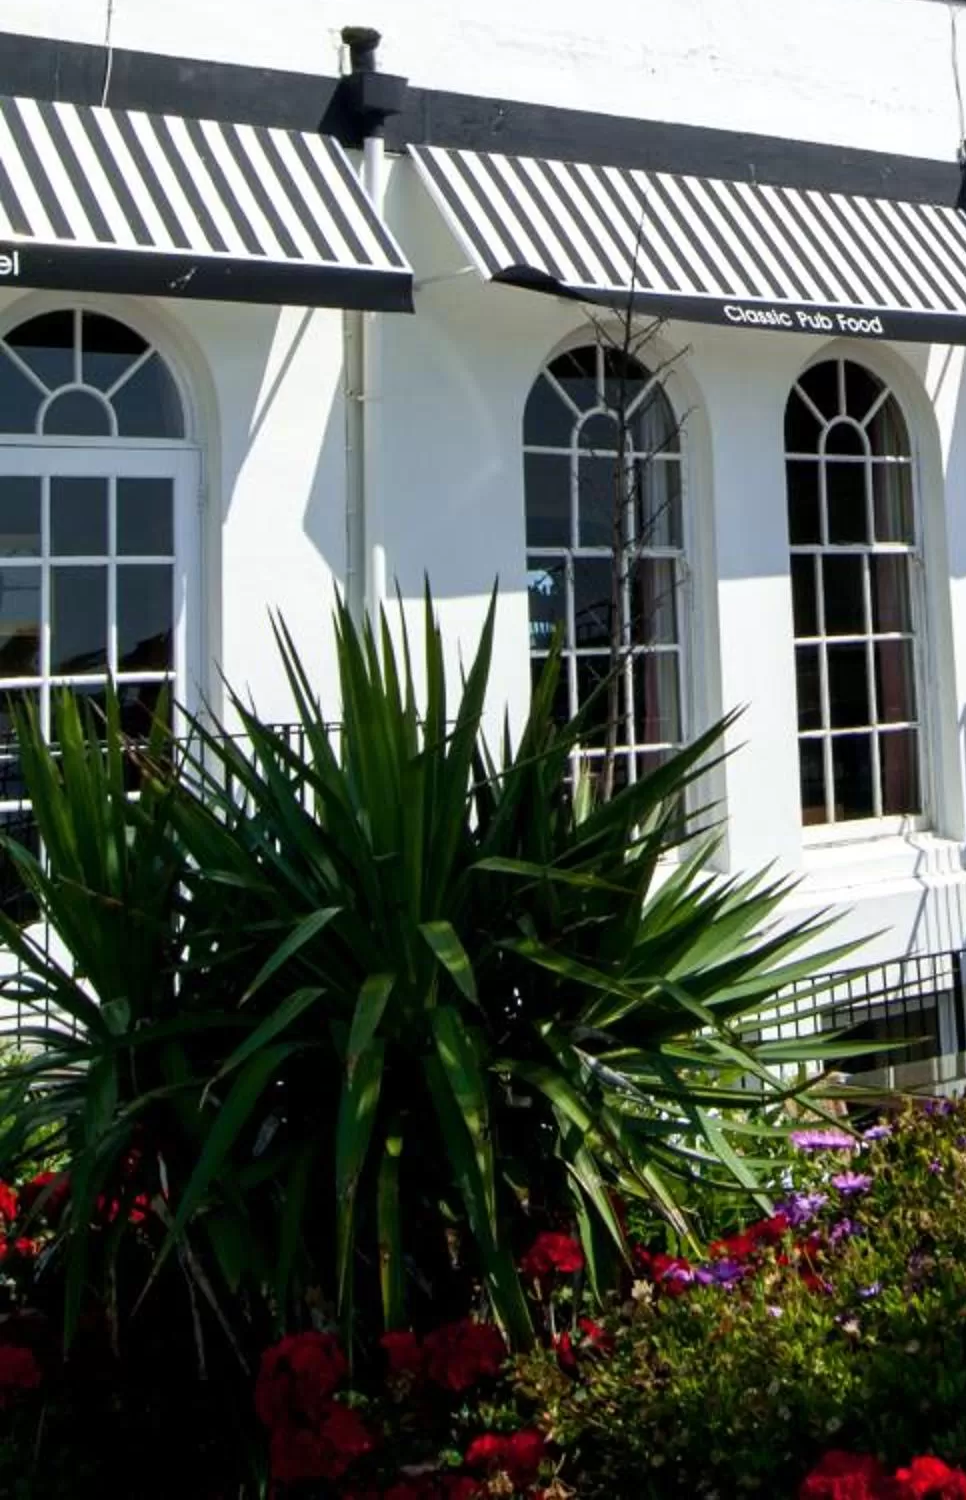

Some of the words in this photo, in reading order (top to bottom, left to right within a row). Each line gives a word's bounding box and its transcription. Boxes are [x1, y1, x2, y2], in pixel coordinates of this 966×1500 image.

[723, 305, 793, 327] Classic
[797, 311, 834, 331] Pub
[836, 313, 884, 334] Food
